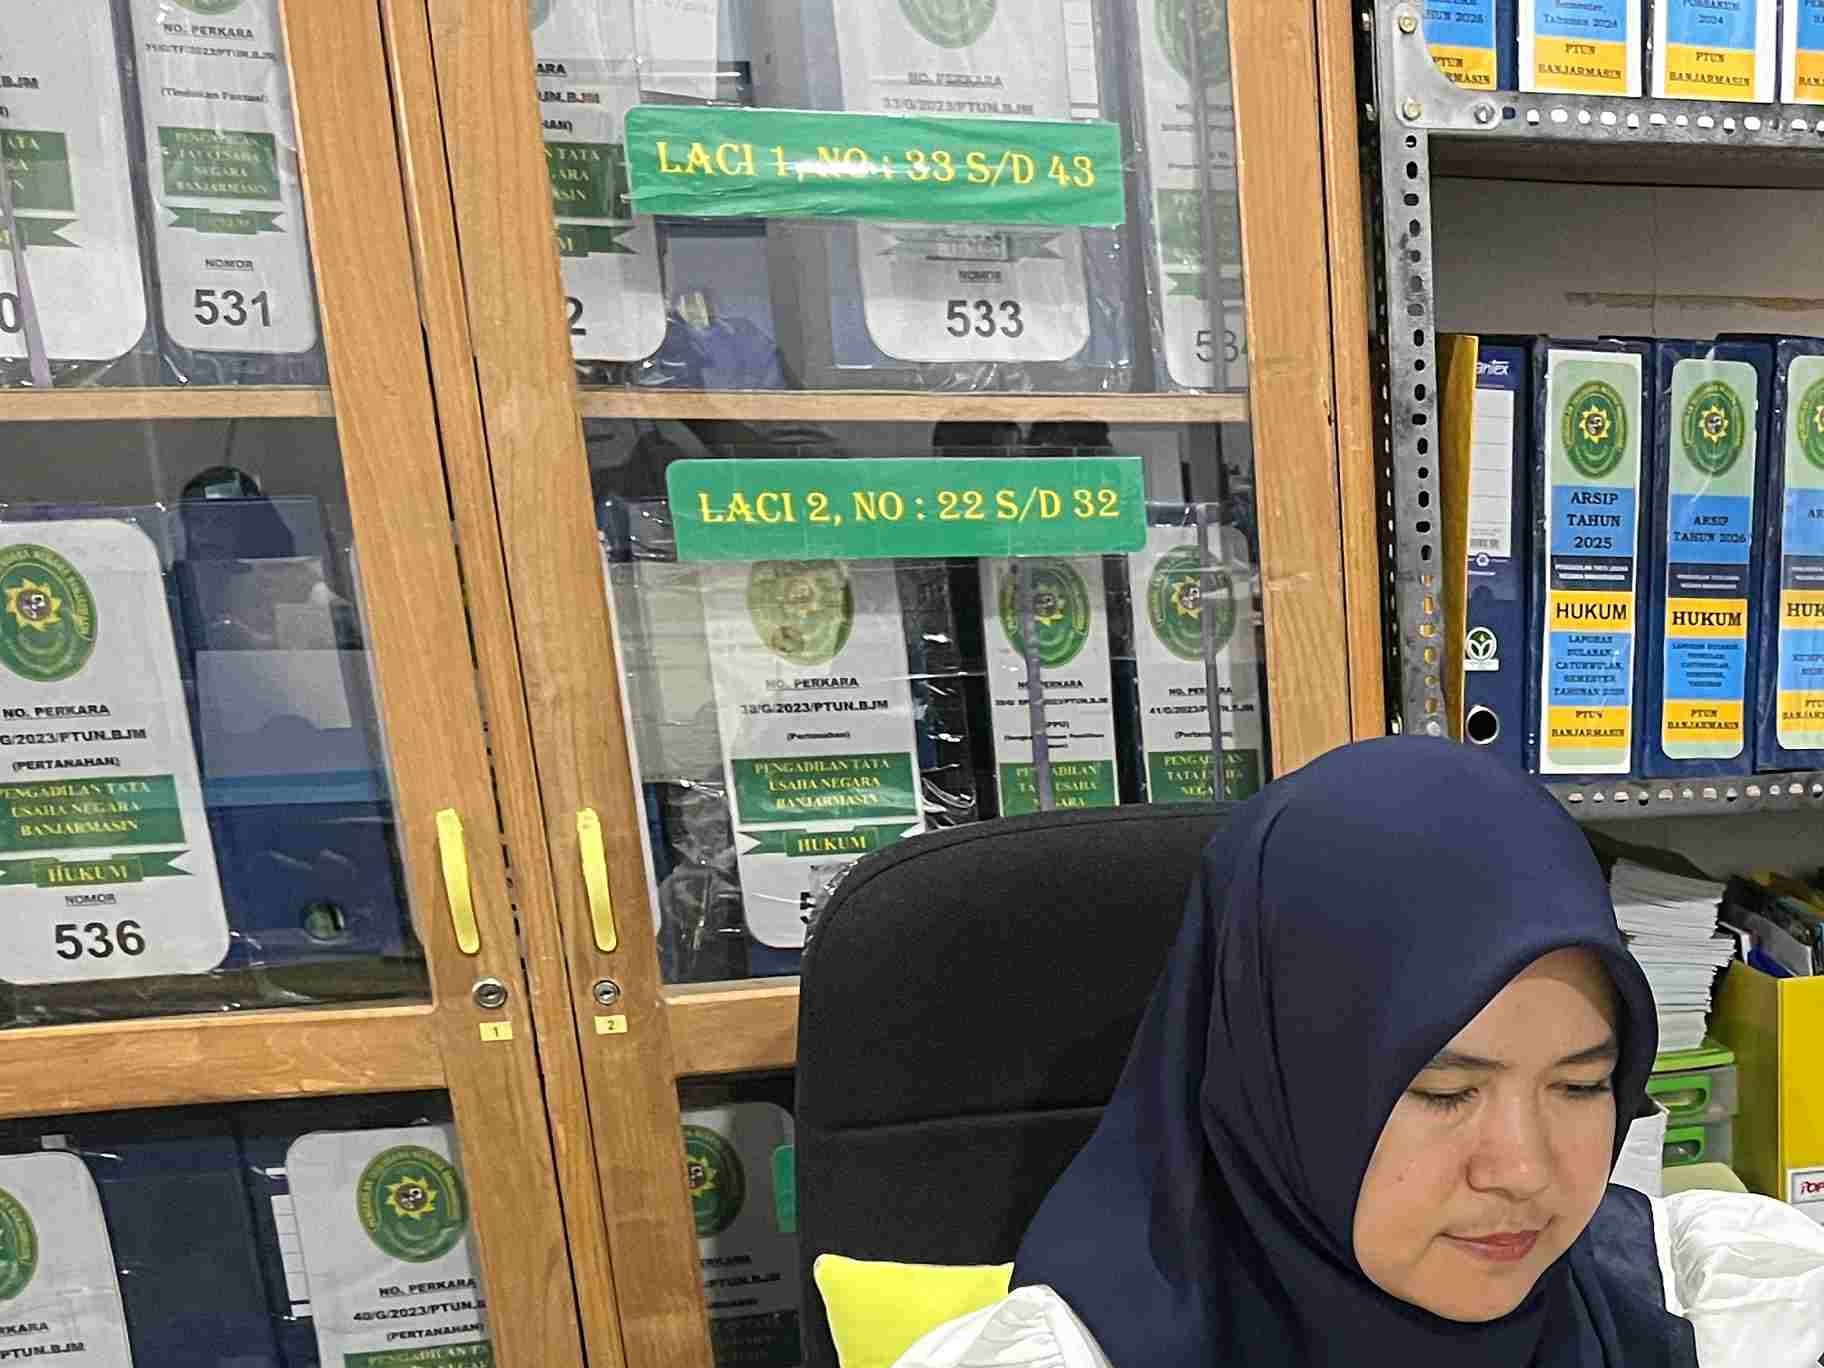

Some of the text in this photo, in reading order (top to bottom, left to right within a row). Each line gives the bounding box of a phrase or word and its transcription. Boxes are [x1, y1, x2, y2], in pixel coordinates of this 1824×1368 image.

[191, 24, 254, 39] PERKARA
[1565, 43, 1596, 55] PTUN
[1695, 52, 1725, 63] PTUN
[1538, 63, 1623, 80] BANJARMASIN
[1668, 71, 1751, 88] BANJARMASIN
[656, 141, 760, 177] LACI
[905, 150, 956, 183] 33
[965, 149, 1036, 189] S/D
[1046, 154, 1097, 189] 43
[204, 258, 254, 271] NOMOR
[193, 288, 271, 328] 531
[945, 299, 1025, 339] 533
[1570, 491, 1619, 505] ARSIP
[697, 491, 798, 524] LACI
[806, 492, 842, 527] 2,
[853, 491, 904, 523] NO
[937, 490, 985, 521] 22
[995, 485, 1063, 524] S/D
[1071, 488, 1120, 520] 32
[1566, 513, 1621, 528] TAHUN
[1693, 515, 1729, 527] ARSIP
[1573, 536, 1613, 549] 2025
[1673, 531, 1715, 543] TAHUN
[1555, 602, 1628, 621] HUKUM
[1671, 611, 1743, 627] HUKUM
[1567, 634, 1613, 645] LAPORAN
[793, 676, 860, 690] PERKARA
[2, 704, 111, 720] NO. PERKARA
[1574, 709, 1604, 721] PTUN
[1690, 709, 1719, 719] PTUN
[1550, 727, 1626, 739] BANJARMASIN
[1667, 721, 1740, 731] BANJARMASIN
[11, 755, 121, 772] (PERTANAHAN)
[754, 759, 892, 776] PENGADILAN TATA
[107, 781, 152, 795] TATA
[767, 776, 882, 792] USAHA NEGARA
[11, 800, 143, 818] USAHA NEGARA
[19, 818, 139, 837] BANJARMASIN
[797, 835, 867, 853] HUKUM
[48, 863, 129, 884] HUKUM
[64, 892, 117, 906] NOMOR
[53, 918, 147, 960] 536
[607, 1019, 616, 1031] 2
[379, 1278, 478, 1298] NO. PERKARA
